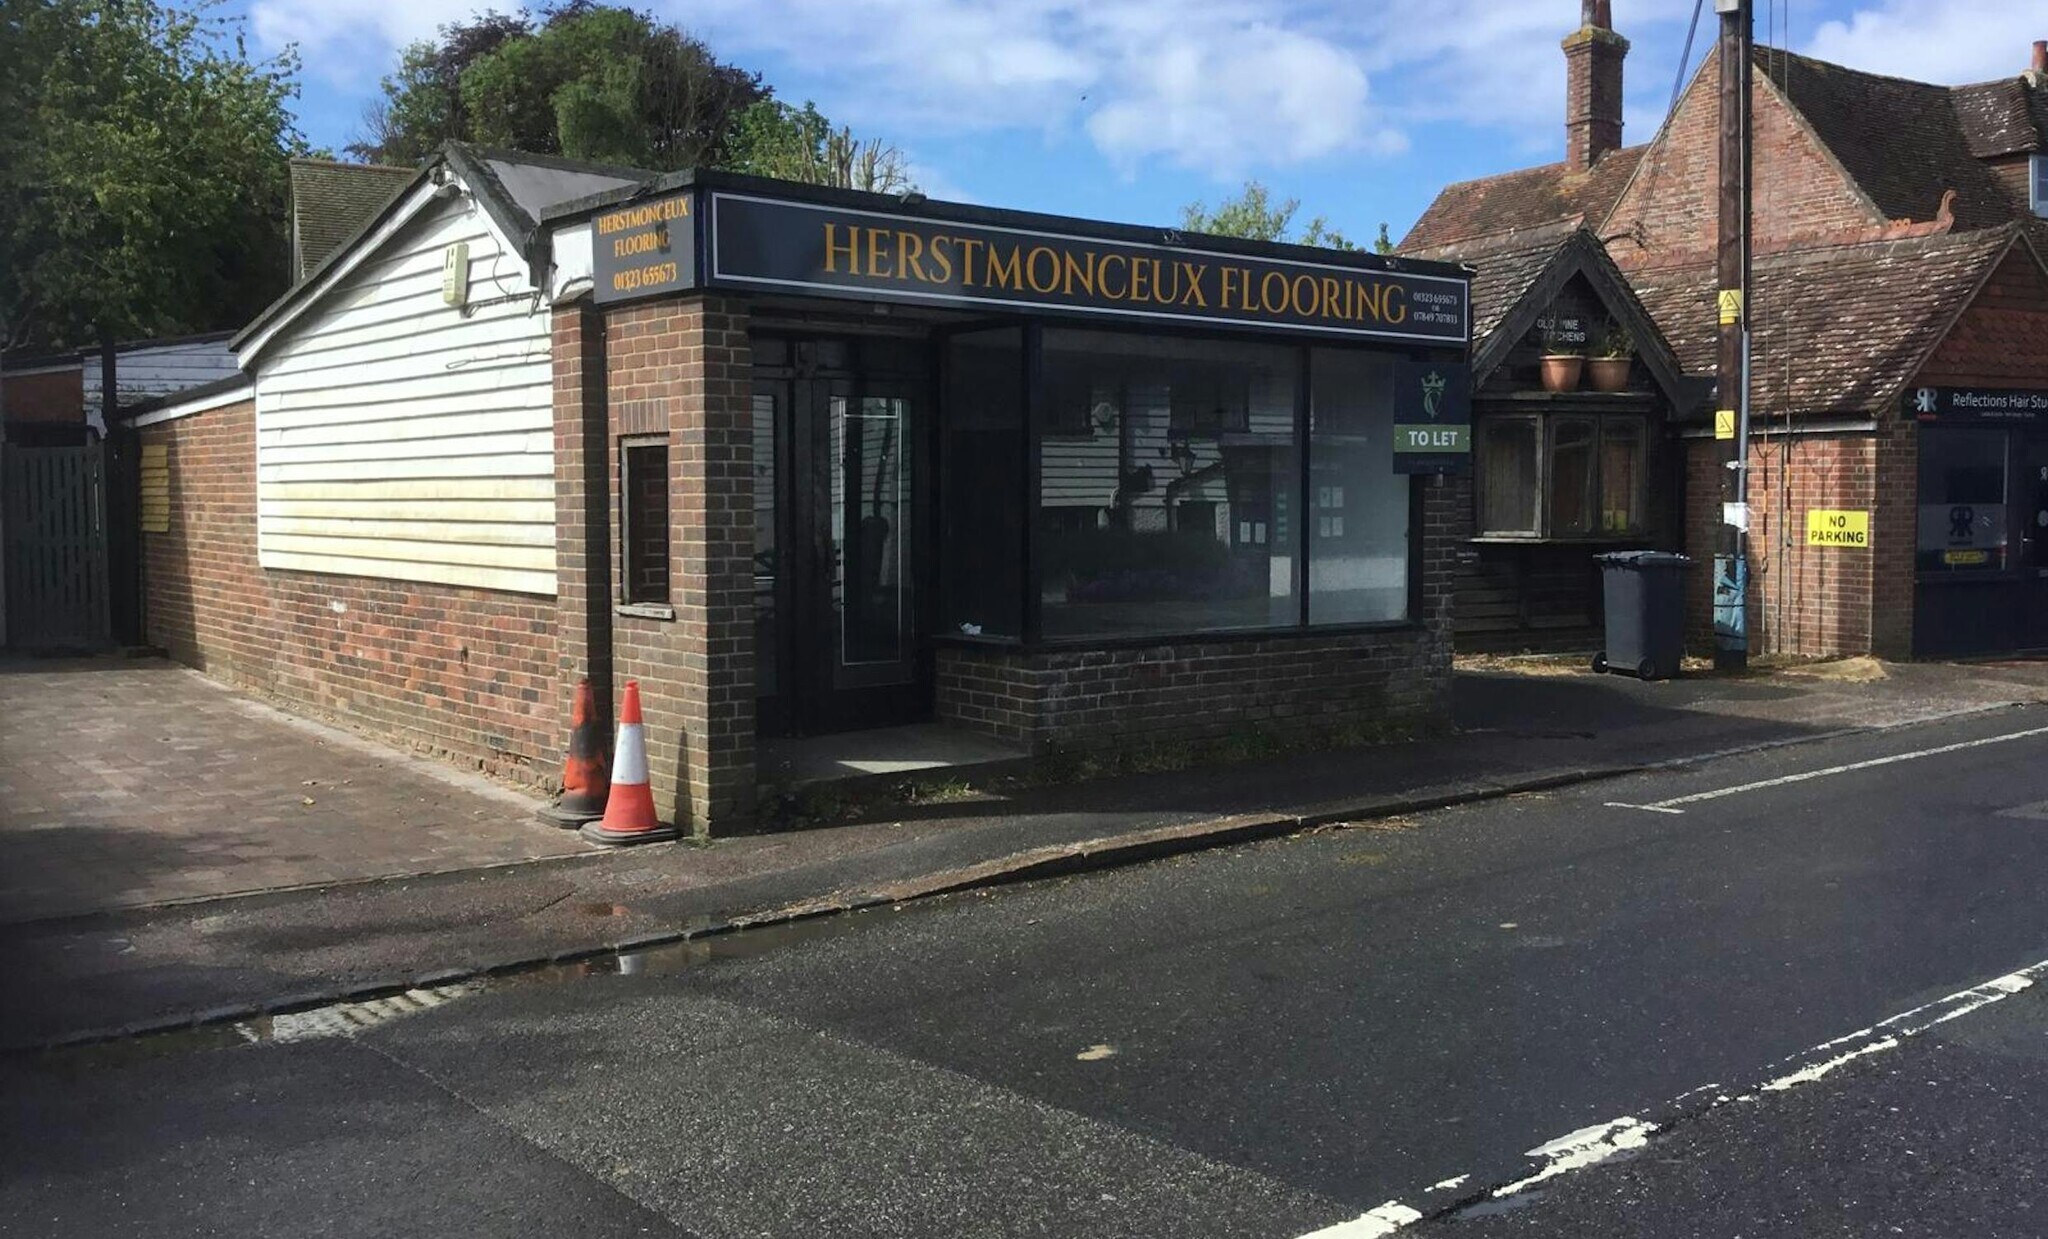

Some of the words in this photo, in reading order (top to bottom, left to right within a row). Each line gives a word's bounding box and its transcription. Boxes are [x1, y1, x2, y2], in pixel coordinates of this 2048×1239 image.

[598, 197, 688, 235] HERSTMONCEUX
[615, 229, 670, 257] FLOORING
[614, 269, 641, 291] 01323
[643, 262, 677, 286] 655673
[823, 222, 1208, 307] HERSTMONCEUX
[1220, 266, 1408, 324] FLOORING
[1952, 392, 2007, 408] Reflections
[2009, 394, 2029, 409] Hair
[1408, 430, 1429, 446] TO
[1432, 431, 1458, 446] LET
[1828, 515, 1846, 528] NO
[1810, 530, 1865, 544] PARKING
